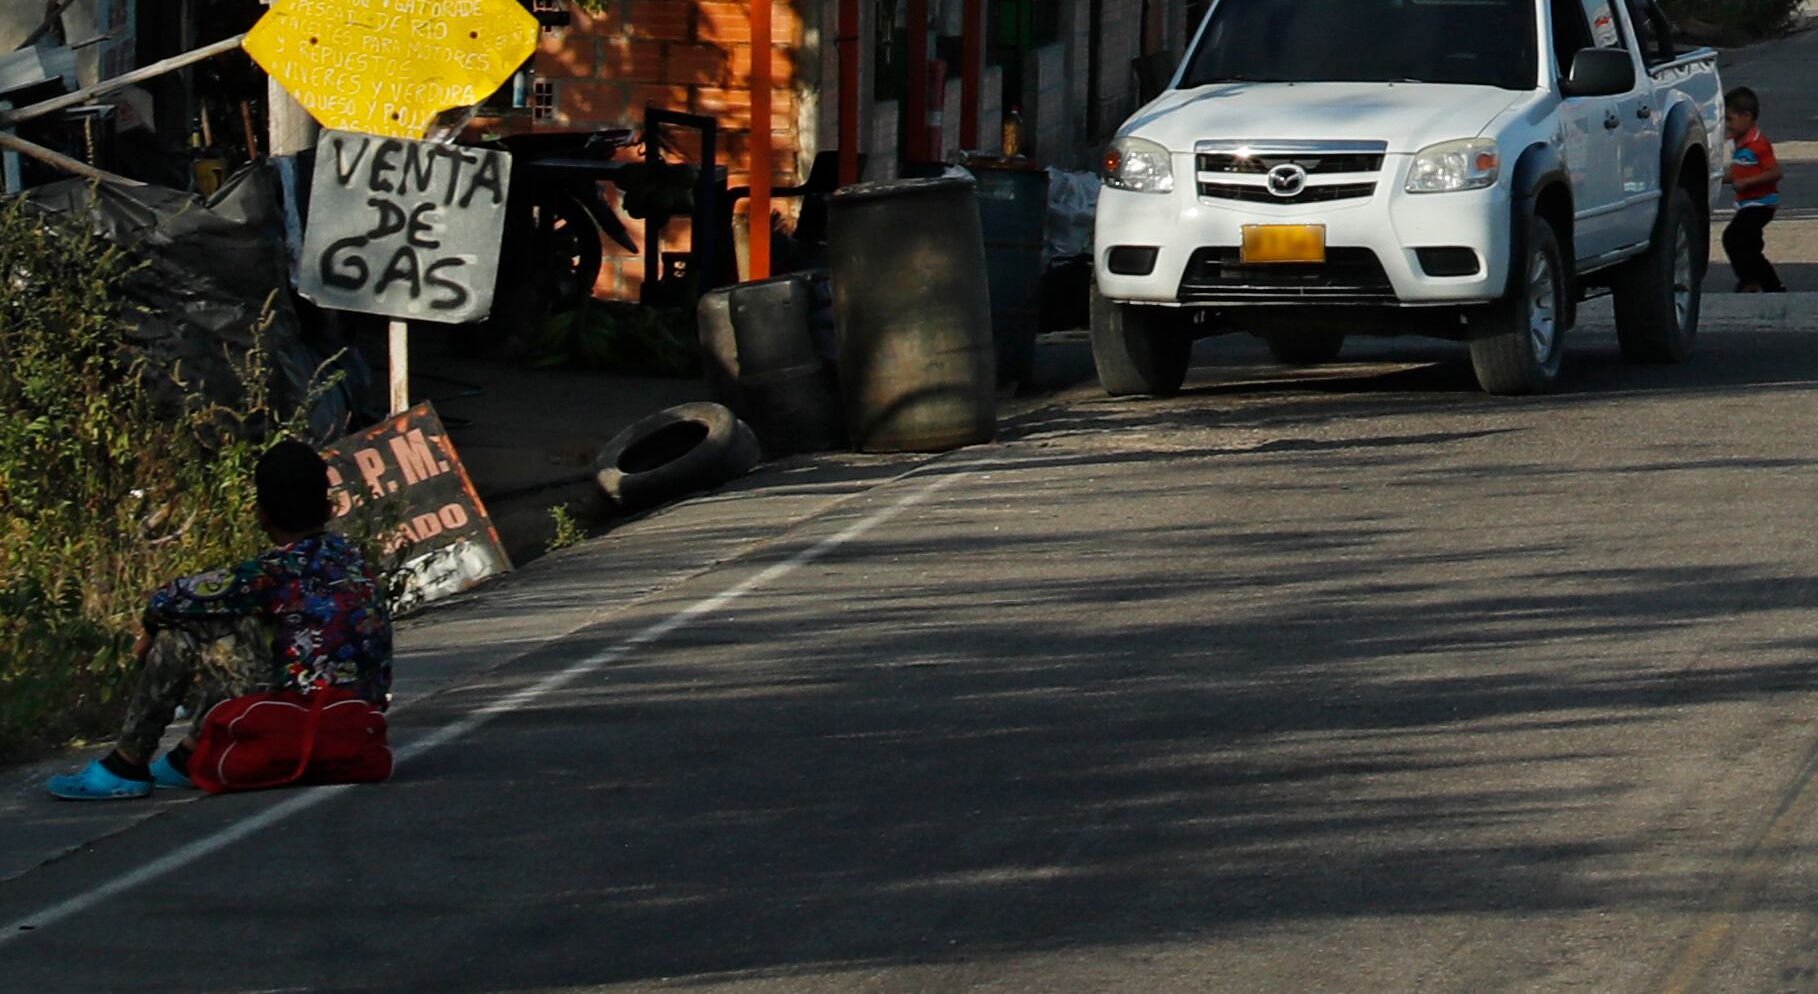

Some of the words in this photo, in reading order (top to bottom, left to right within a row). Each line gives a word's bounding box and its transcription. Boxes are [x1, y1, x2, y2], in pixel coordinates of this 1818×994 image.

[332, 137, 503, 207] VENTA
[366, 197, 441, 250] DE
[319, 234, 468, 308] GAS
